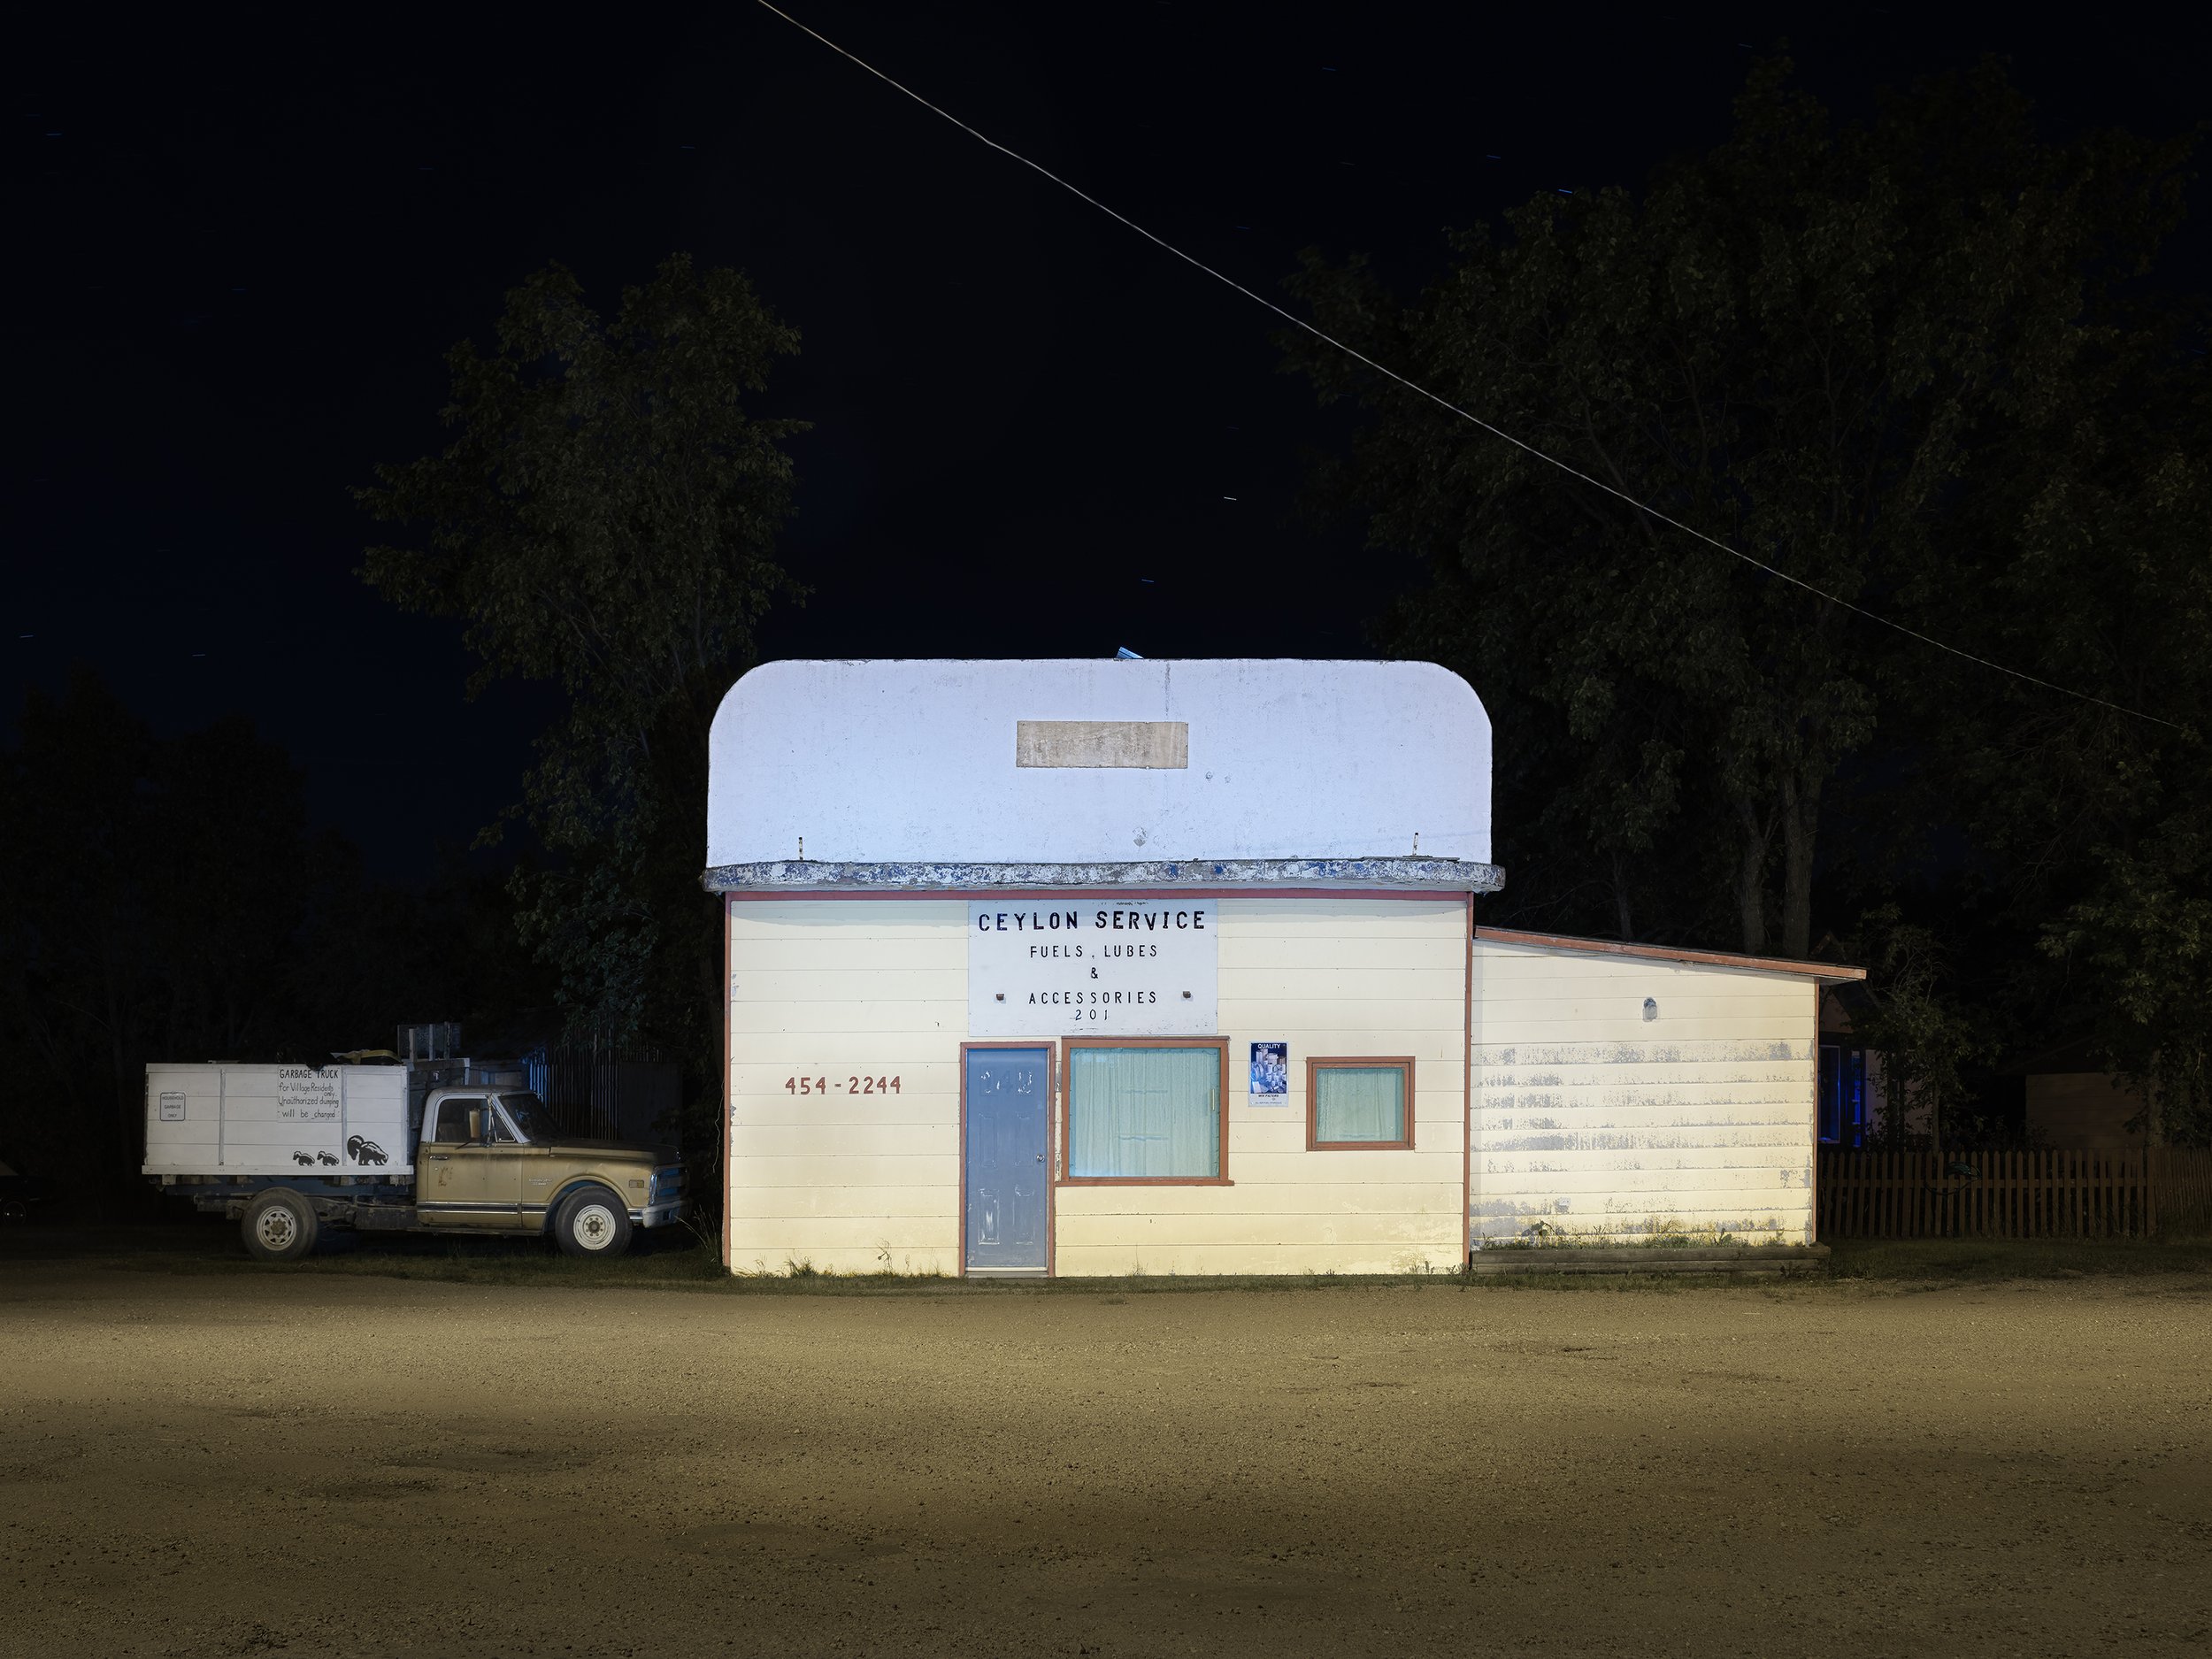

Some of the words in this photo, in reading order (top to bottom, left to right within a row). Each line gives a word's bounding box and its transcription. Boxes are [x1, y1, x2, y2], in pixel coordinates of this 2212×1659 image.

[979, 911, 1078, 932] CEYLON
[1094, 910, 1205, 930] SERVICE
[1104, 945, 1158, 957] LUBES
[1090, 967, 1099, 979] &
[1028, 991, 1157, 1005] ACCESSORIES
[1075, 1009, 1108, 1021] 201
[279, 1069, 312, 1079] GARBAGE
[317, 1069, 339, 1079] TRUCK
[278, 1081, 289, 1092] for
[289, 1082, 310, 1094] Village
[281, 1108, 295, 1118] will
[300, 1109, 309, 1118] be
